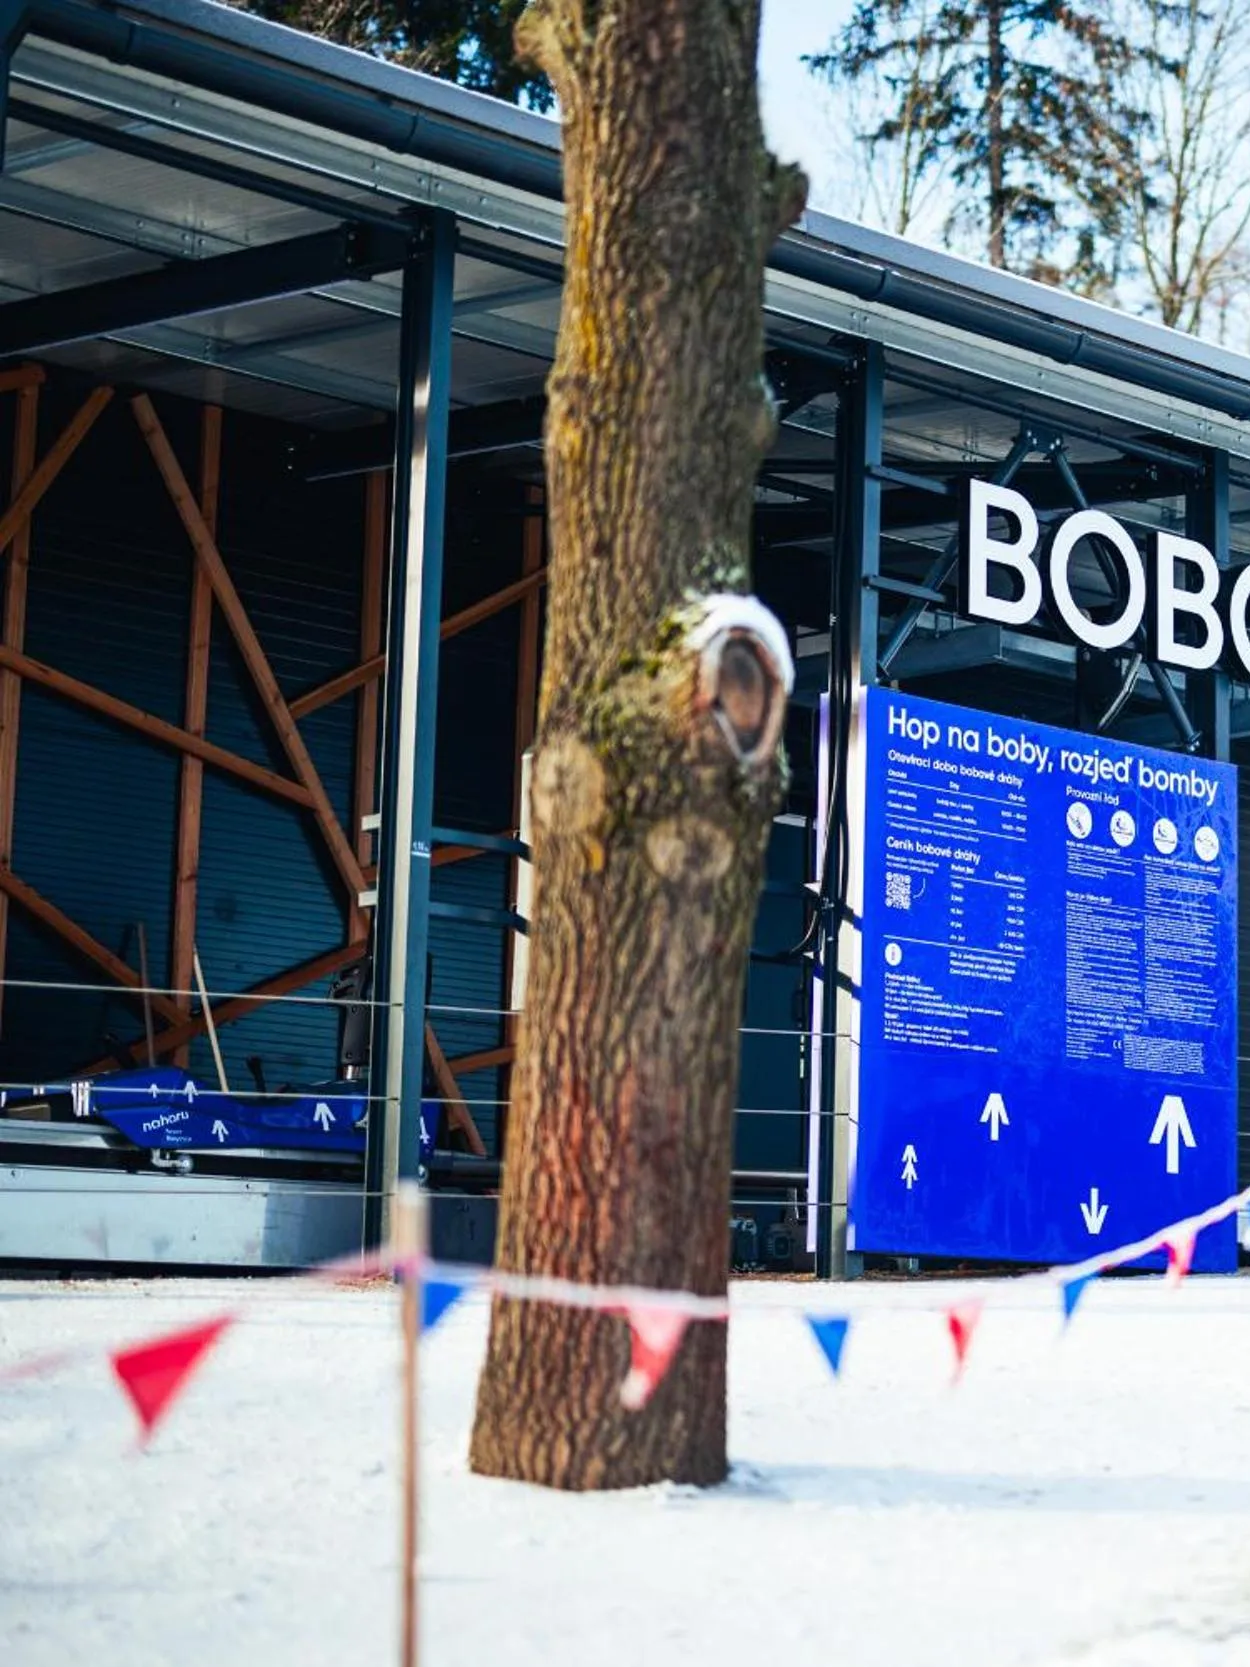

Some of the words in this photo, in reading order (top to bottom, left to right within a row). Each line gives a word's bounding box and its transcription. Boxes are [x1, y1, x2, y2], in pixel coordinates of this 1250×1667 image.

[888, 705, 940, 749] Hop
[947, 726, 980, 753] na
[987, 727, 1054, 774] boby,
[1060, 748, 1134, 784] rozjeď
[1138, 759, 1219, 806] bomby
[933, 760, 958, 774] doba
[960, 764, 995, 781] bobové
[996, 772, 1024, 789] dráhy
[886, 836, 914, 851] Ceník
[916, 841, 952, 858] bobové
[953, 848, 981, 866] dráhy
[142, 1111, 190, 1133] nahoru
